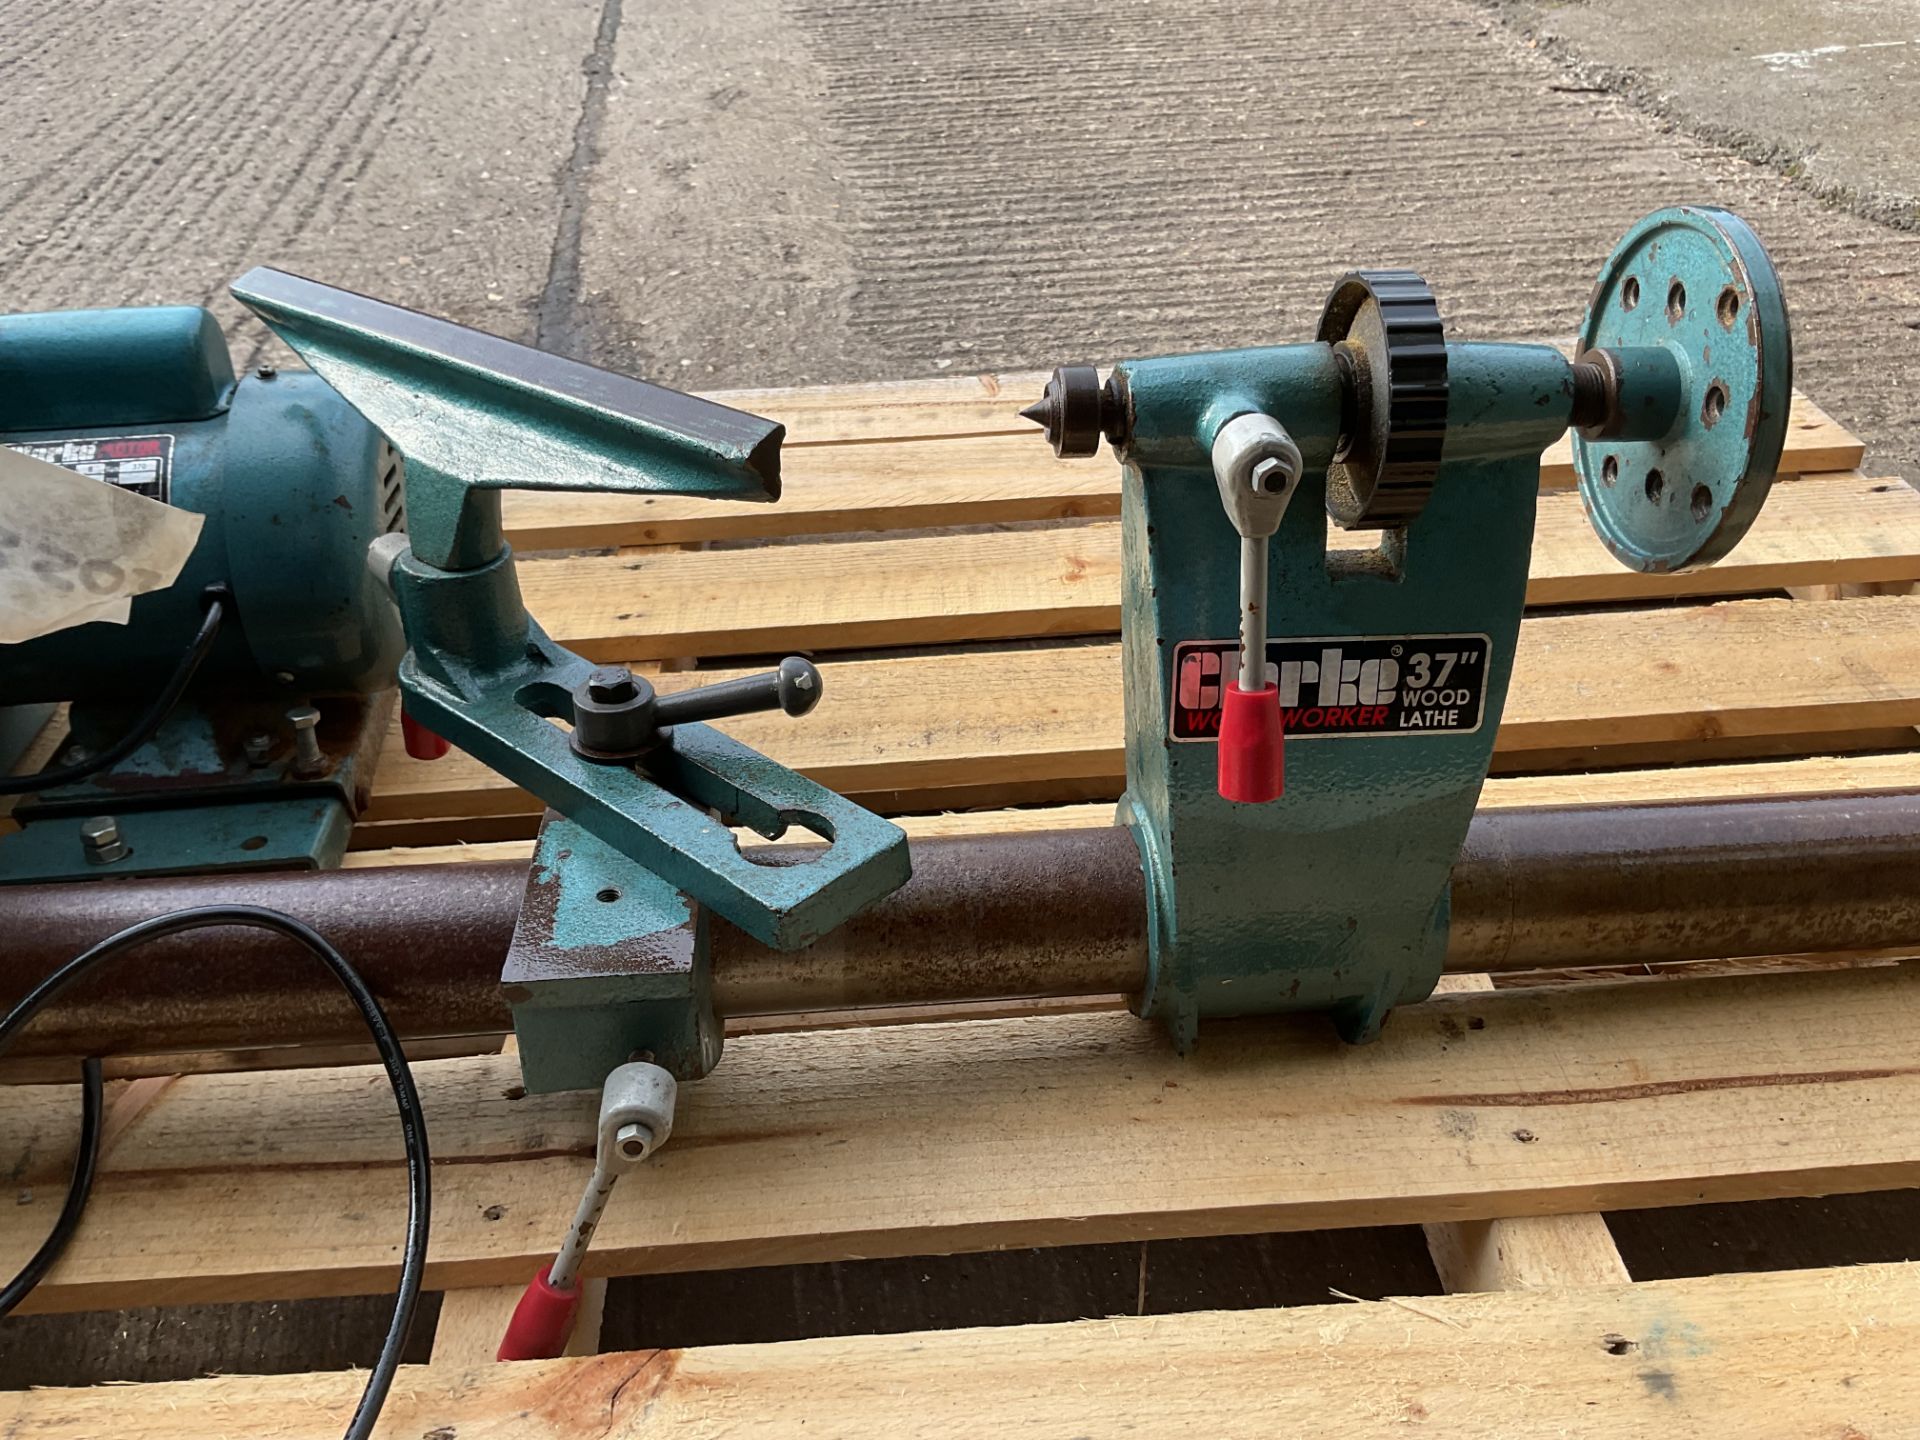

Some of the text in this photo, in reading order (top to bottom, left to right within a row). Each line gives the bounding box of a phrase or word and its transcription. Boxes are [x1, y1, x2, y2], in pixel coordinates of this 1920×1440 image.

[1179, 648, 1400, 709] Clrke
[1402, 688, 1471, 707] WOOD
[1399, 709, 1459, 728] LATHE
